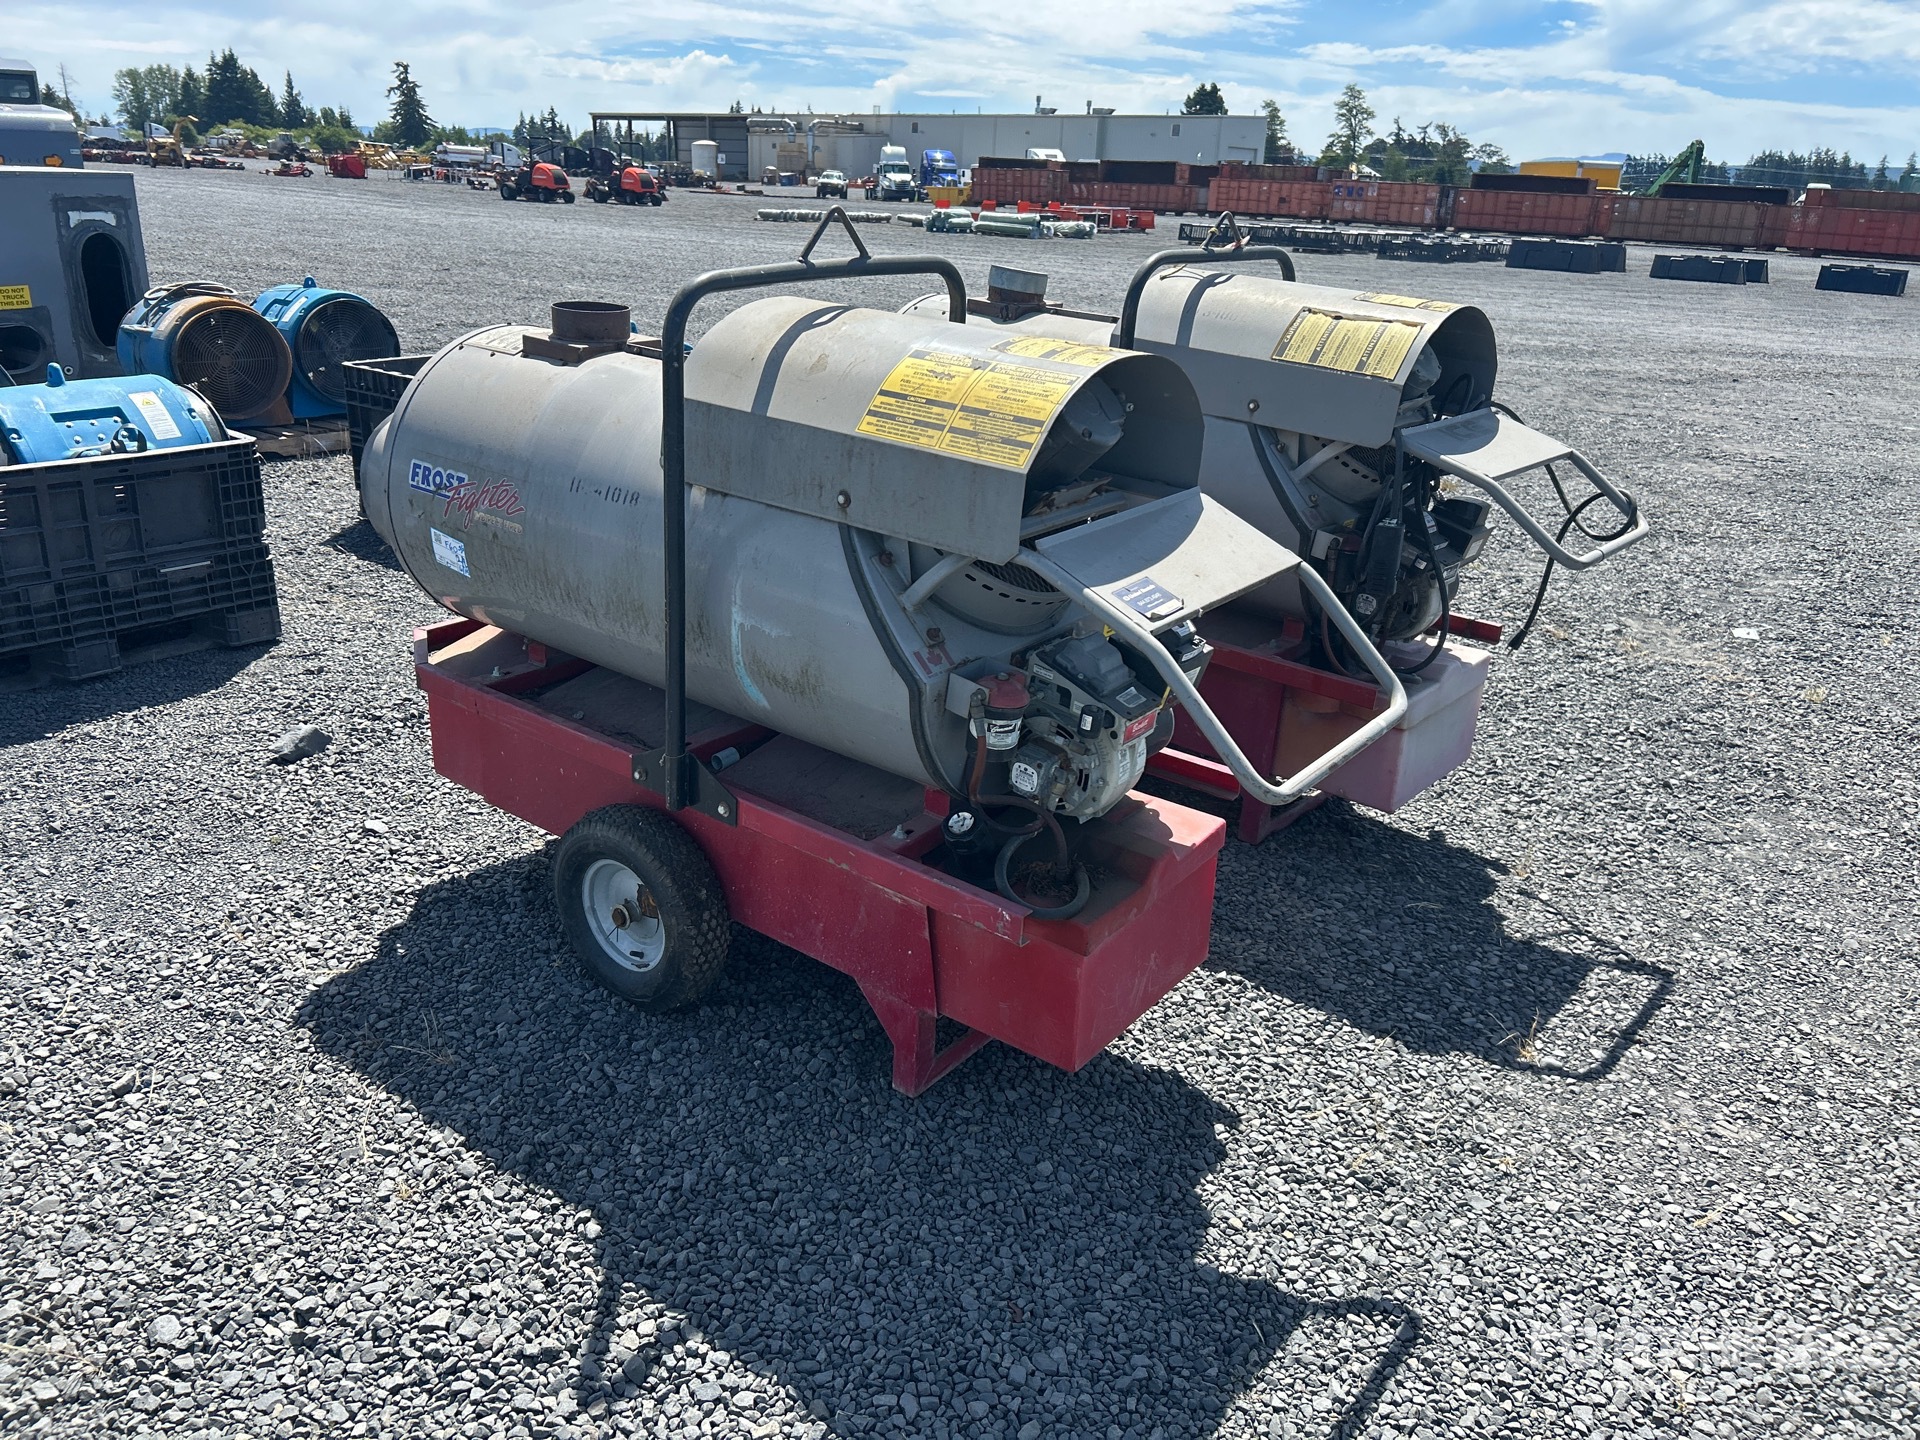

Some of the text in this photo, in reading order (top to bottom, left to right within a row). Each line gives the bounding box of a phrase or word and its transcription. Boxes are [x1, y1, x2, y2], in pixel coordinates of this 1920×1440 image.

[1284, 317, 1303, 343] CAUTION
[1316, 320, 1339, 351] ATTENTION
[410, 462, 466, 496] FROST
[443, 478, 526, 530] Fighter
